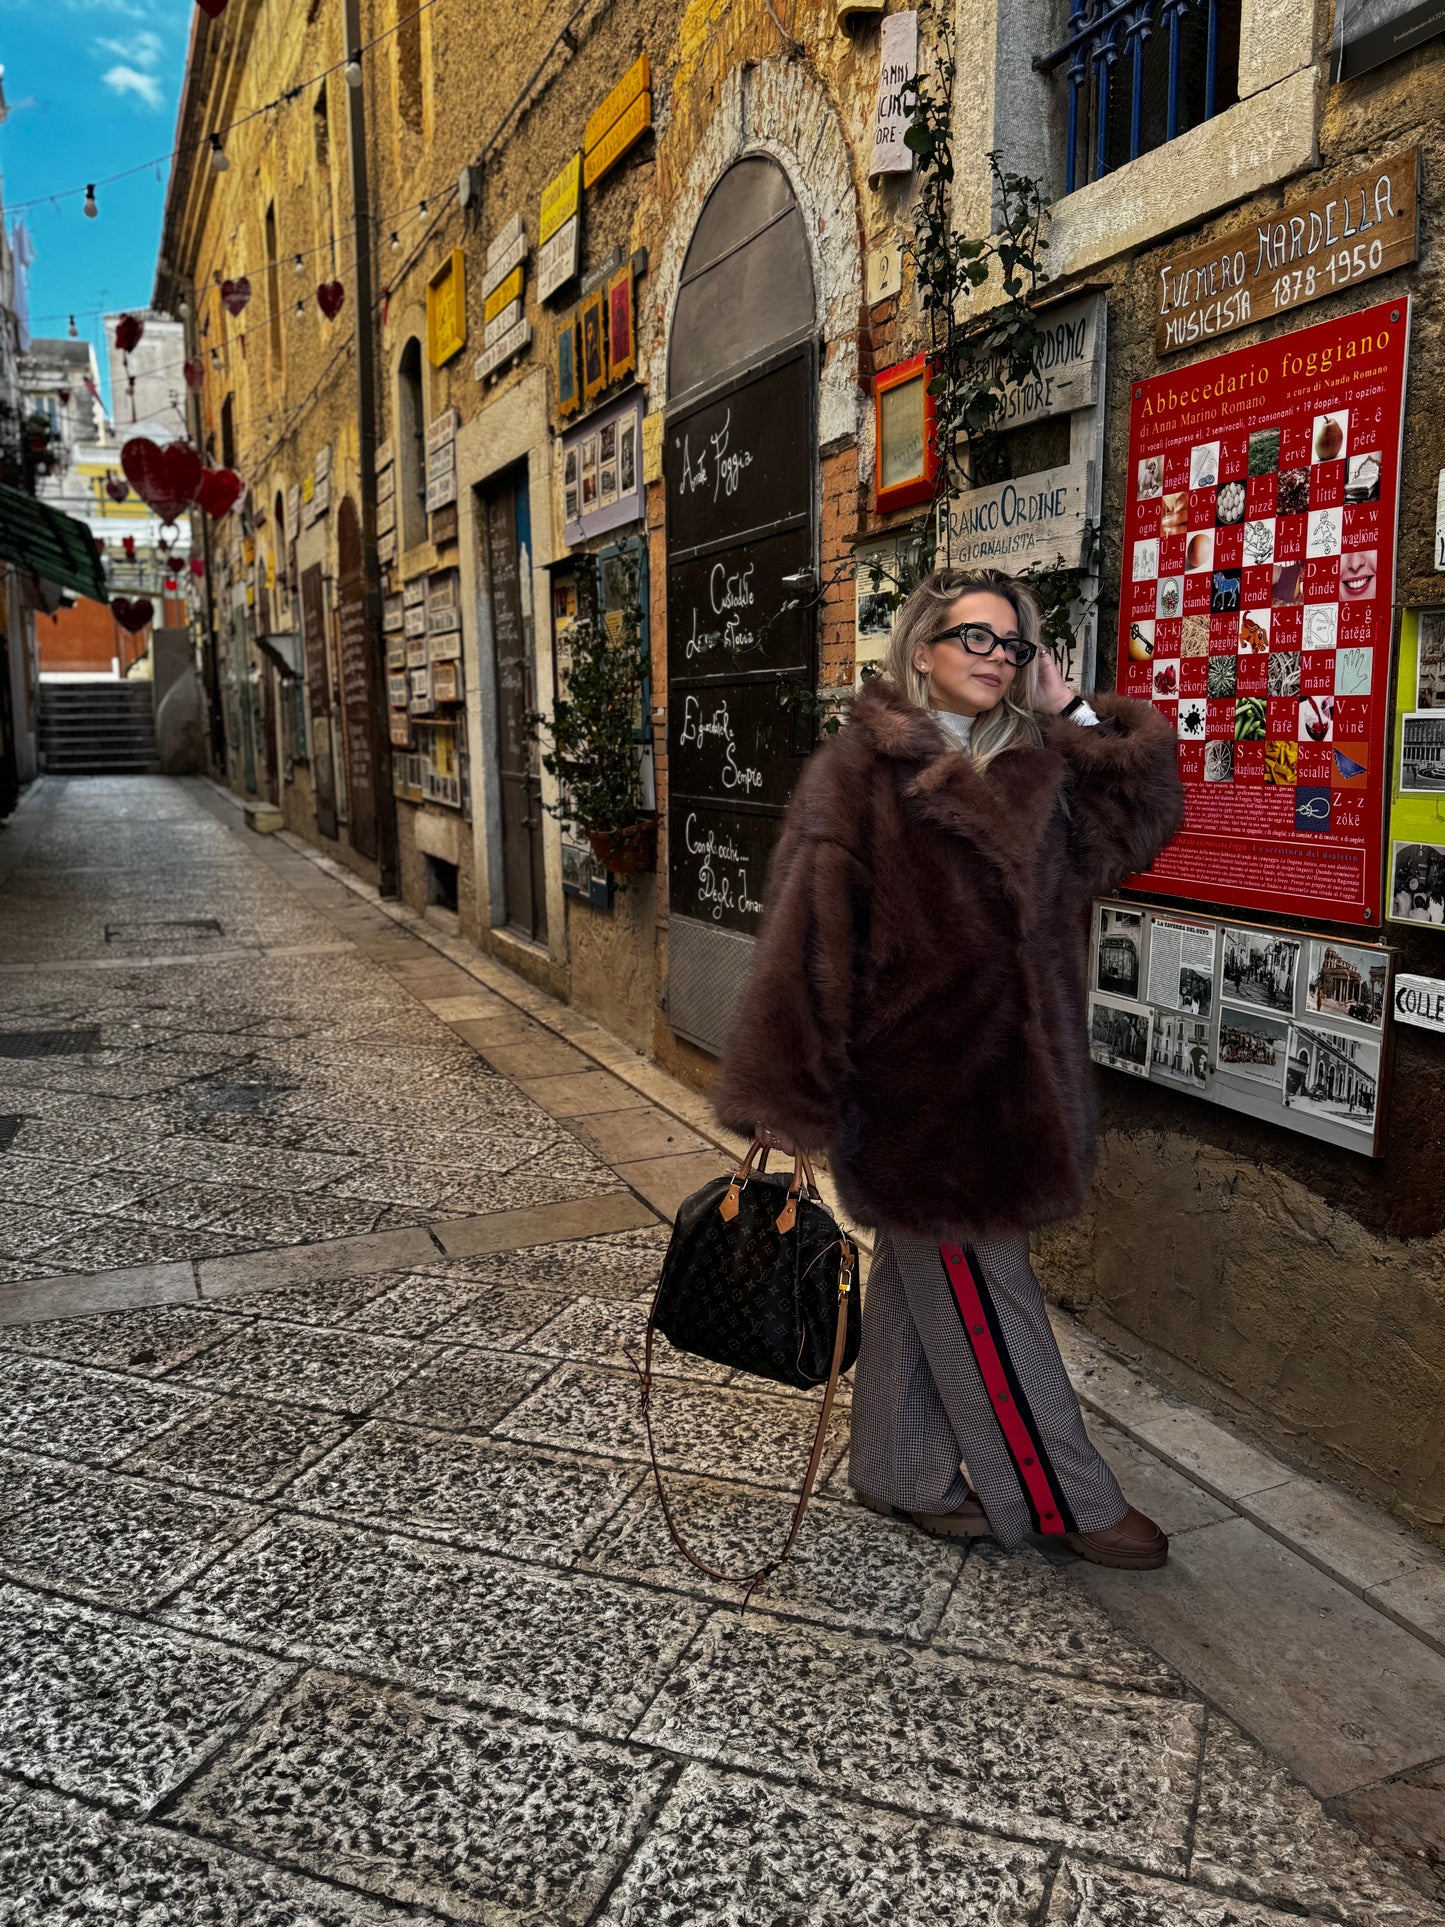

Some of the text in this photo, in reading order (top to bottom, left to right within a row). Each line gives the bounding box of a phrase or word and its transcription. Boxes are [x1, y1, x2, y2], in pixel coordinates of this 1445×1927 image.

[880, 255, 889, 290] 2
[1165, 239, 1383, 349] MUSICISTA 1878-1950
[1141, 331, 1389, 417] Abbecedario foggiano
[1293, 387, 1311, 397] cura
[1313, 381, 1321, 391] di
[1324, 376, 1350, 388] Nando
[1353, 365, 1388, 380] Romano
[1248, 416, 1256, 426] 22
[1303, 401, 1312, 412] 19
[1345, 390, 1353, 401] 12
[1140, 395, 1266, 438] di Anna Marino Romano
[1283, 428, 1311, 444] E e
[1165, 459, 1173, 472] A
[1137, 505, 1144, 518] O
[1343, 510, 1355, 526] W
[938, 500, 999, 543] FRANCO
[1279, 521, 1285, 536] J
[959, 533, 1035, 562] GIORNALISTA
[1307, 560, 1339, 578] D d
[1186, 577, 1211, 591] B b
[1245, 570, 1252, 585] T
[1134, 586, 1139, 598] P
[1272, 611, 1302, 626] K k
[1182, 663, 1189, 675] C
[1240, 659, 1247, 673] G
[1302, 656, 1312, 670] M
[1129, 665, 1136, 678] G
[1270, 702, 1277, 715] F
[1336, 701, 1346, 715] V
[1180, 744, 1187, 757] R
[1237, 745, 1244, 758] S
[1298, 746, 1309, 760] Sc
[1333, 792, 1342, 807] Z
